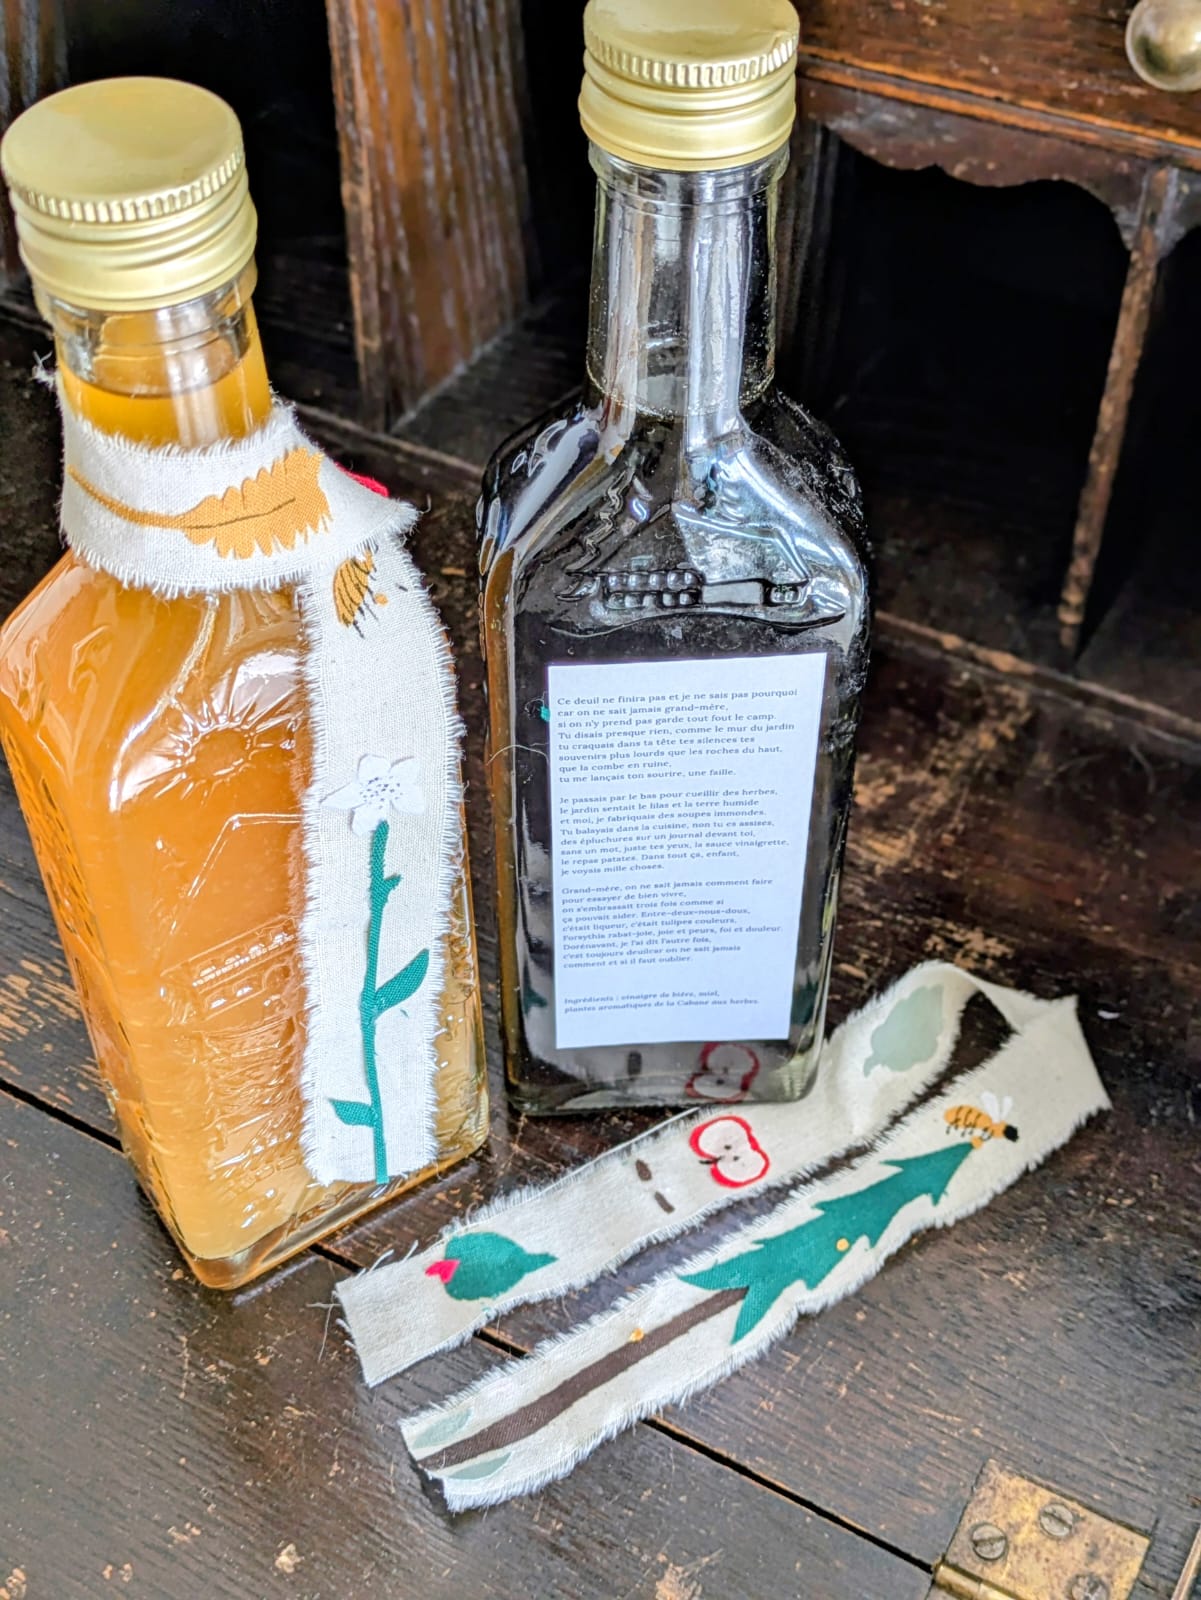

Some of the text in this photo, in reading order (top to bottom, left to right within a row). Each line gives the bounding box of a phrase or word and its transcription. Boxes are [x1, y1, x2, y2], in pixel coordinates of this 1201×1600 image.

[557, 697, 571, 706] Ce
[574, 696, 600, 706] deuil
[618, 694, 646, 704] finira
[648, 694, 666, 704] pas
[669, 693, 679, 702] et
[682, 693, 691, 704] je
[709, 691, 729, 700] sais
[731, 691, 749, 701] pas
[751, 689, 798, 701] pourquoi
[608, 707, 627, 716] sait
[630, 705, 662, 717] jamais
[558, 721, 566, 729] si
[585, 720, 600, 730] n'y
[602, 718, 632, 730] prend
[635, 718, 653, 727] pas
[655, 715, 684, 727] garde
[687, 714, 709, 723] tout
[711, 713, 732, 722] fout
[735, 713, 744, 722] le
[558, 731, 571, 739] Tu
[574, 730, 603, 740] disais
[606, 729, 646, 740] presque
[675, 727, 712, 735] comme
[714, 725, 724, 734] le
[750, 723, 763, 732] du
[766, 722, 795, 734] jardin
[558, 735, 755, 753] tu craquais dans ta tête tes silences tes
[558, 753, 607, 762] souvenirs
[610, 751, 630, 762] plus
[633, 749, 665, 758] lourds
[667, 749, 686, 758] que
[689, 747, 703, 756] les
[706, 746, 740, 756] roches
[742, 746, 755, 755] du
[559, 765, 577, 774] que
[580, 764, 589, 772] la
[591, 762, 624, 771] combe
[591, 773, 625, 784] lançais
[627, 772, 645, 780] ton
[560, 796, 569, 804] Je
[572, 795, 607, 806] passais
[610, 795, 626, 804] par
[629, 793, 638, 801] le
[640, 792, 657, 800] bas
[659, 792, 683, 801] pour
[685, 789, 720, 798] cueillir
[722, 788, 740, 797] des
[559, 807, 568, 815] le
[571, 806, 599, 817] jardin
[602, 804, 636, 813] sentait
[638, 802, 647, 810] le
[650, 801, 669, 810] lilas
[684, 800, 693, 808] la
[695, 800, 721, 808] terre
[722, 798, 760, 808] humide
[596, 816, 605, 826] je
[607, 813, 655, 824] fabriquais
[658, 811, 675, 820] des
[677, 811, 711, 820] soupes
[560, 828, 573, 836] Tu
[575, 826, 614, 837] balayais
[616, 824, 639, 833] dans
[560, 838, 577, 846] des
[580, 835, 633, 847] épluchures
[669, 831, 703, 842] journal
[705, 830, 738, 839] devant
[624, 844, 647, 854] juste
[572, 858, 599, 867] repas
[641, 852, 665, 861] Dans
[561, 869, 570, 878] je
[572, 867, 601, 877] voyais
[604, 865, 627, 873] mille
